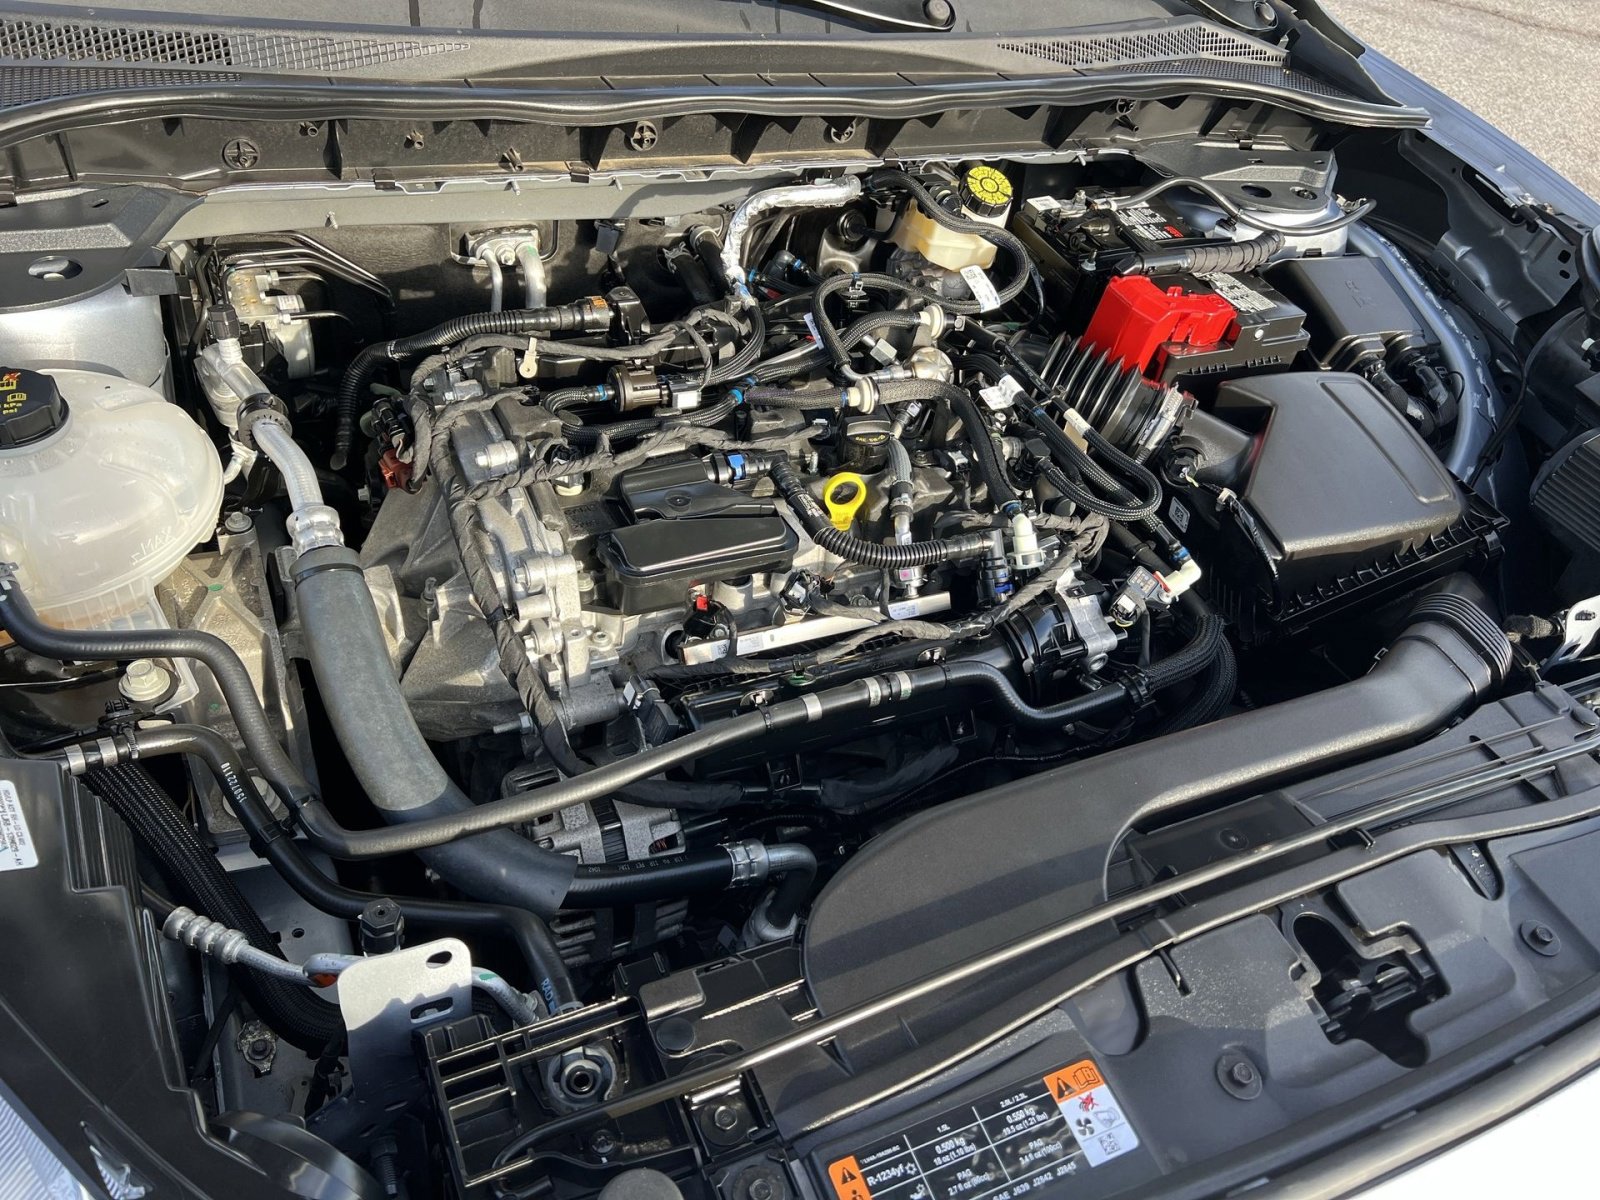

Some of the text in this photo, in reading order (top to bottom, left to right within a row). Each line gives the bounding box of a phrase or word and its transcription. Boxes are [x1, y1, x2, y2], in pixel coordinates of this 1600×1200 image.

[1006, 1107, 1035, 1123] 0.550 kg
[935, 1137, 965, 1154] 0.500 kg
[1028, 1138, 1044, 1150] PAG
[866, 1163, 904, 1187] R-1234yf
[956, 1169, 973, 1180] PAG
